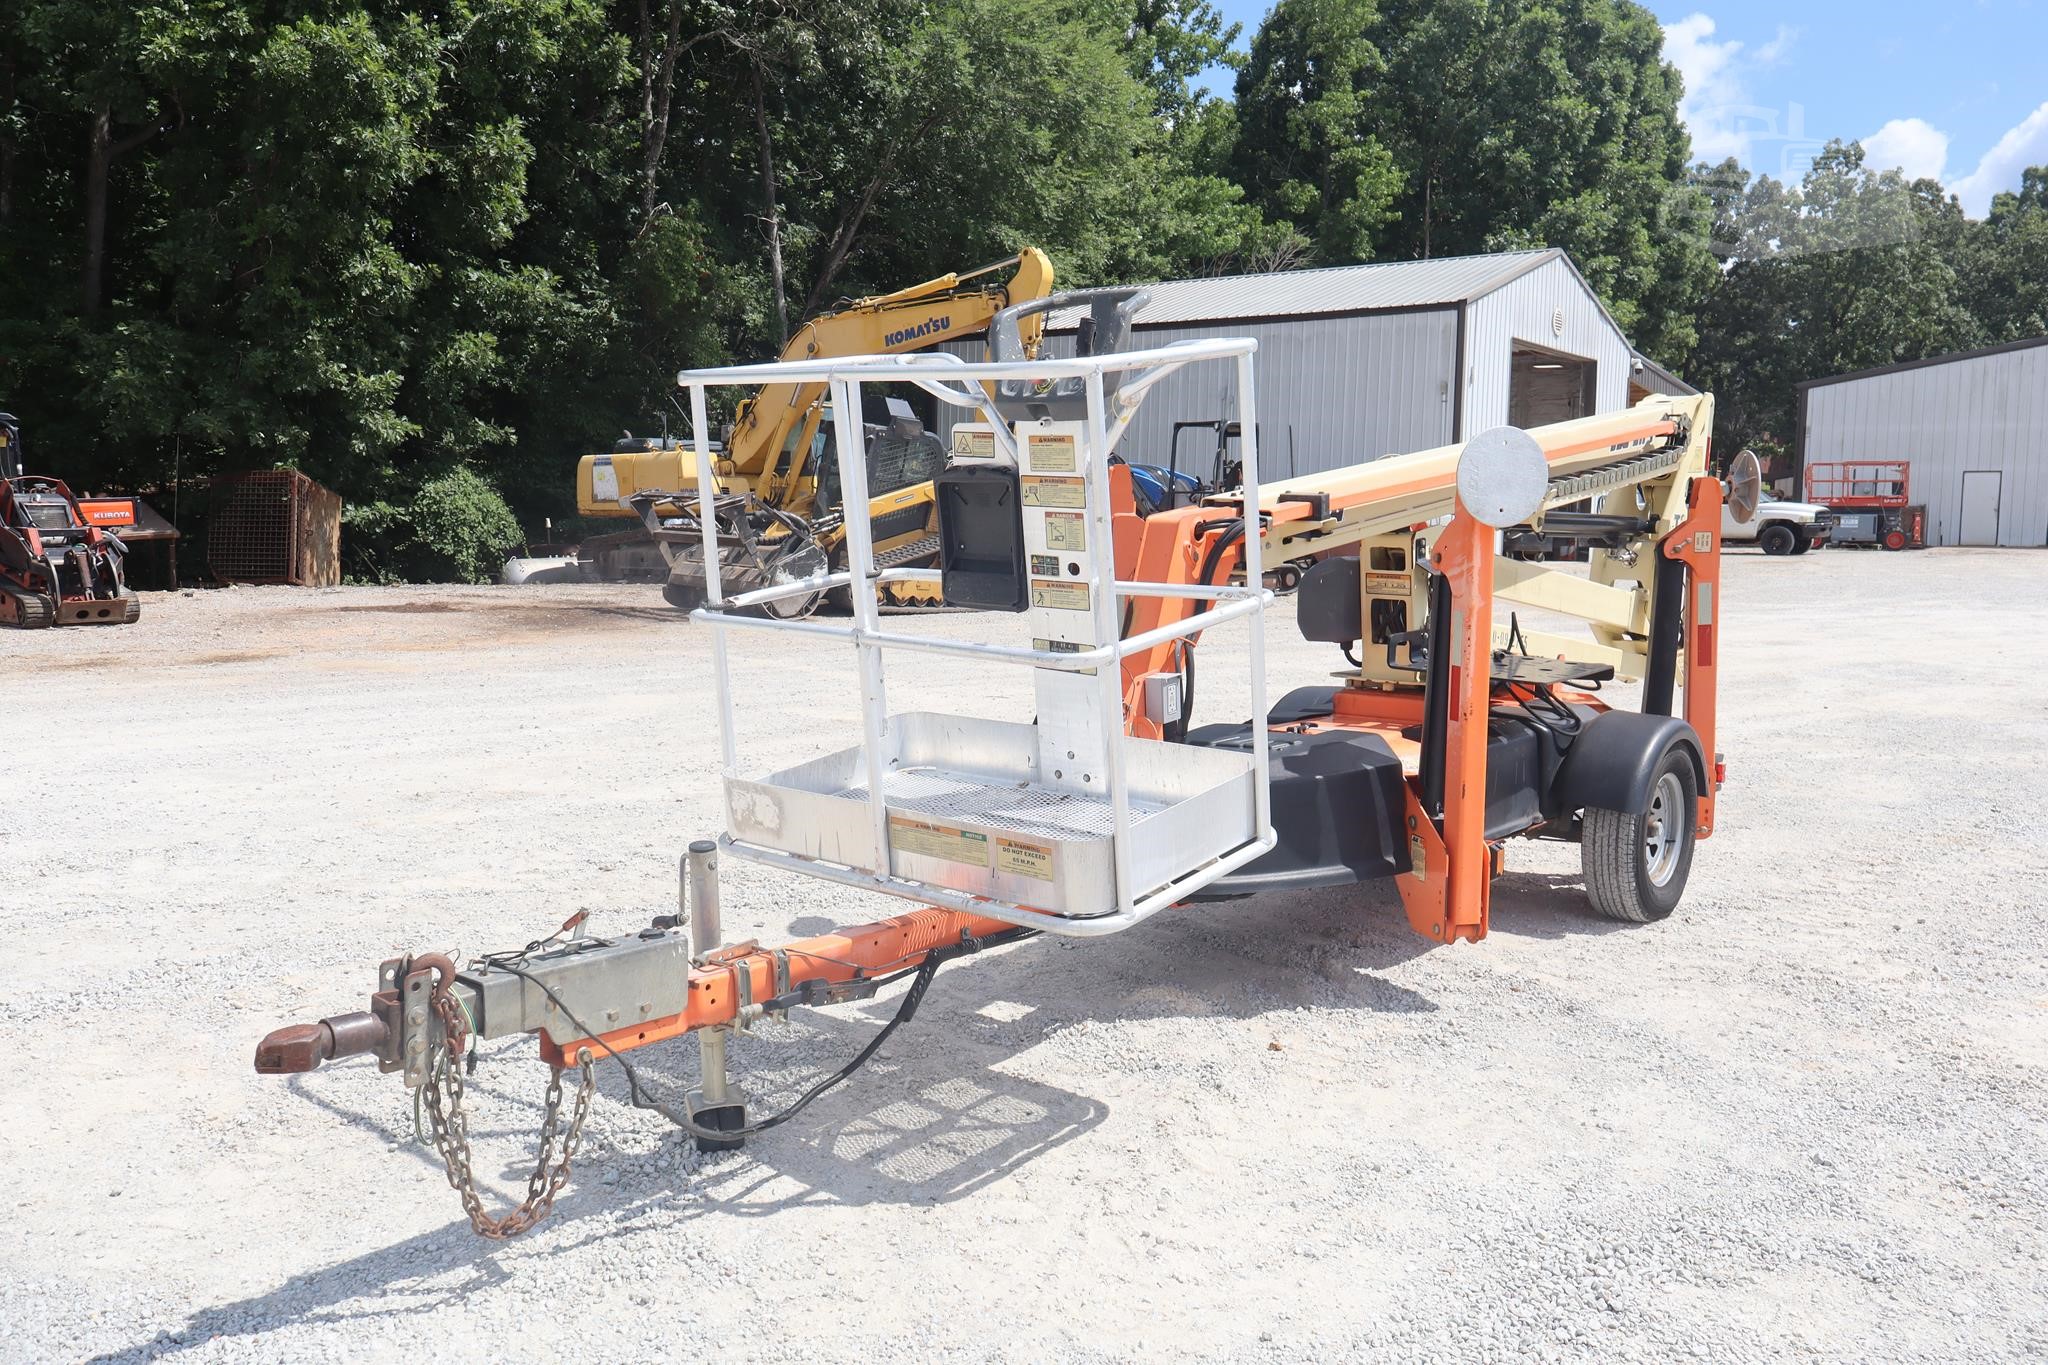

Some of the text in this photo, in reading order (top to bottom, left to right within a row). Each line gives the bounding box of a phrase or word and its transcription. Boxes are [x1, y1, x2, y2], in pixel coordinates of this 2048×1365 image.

[884, 316, 951, 347] KOMATSU
[93, 511, 131, 519] KUBOTA
[1014, 842, 1041, 853] WARNING
[1011, 848, 1023, 856] NOT
[1024, 851, 1046, 861] EXCEED
